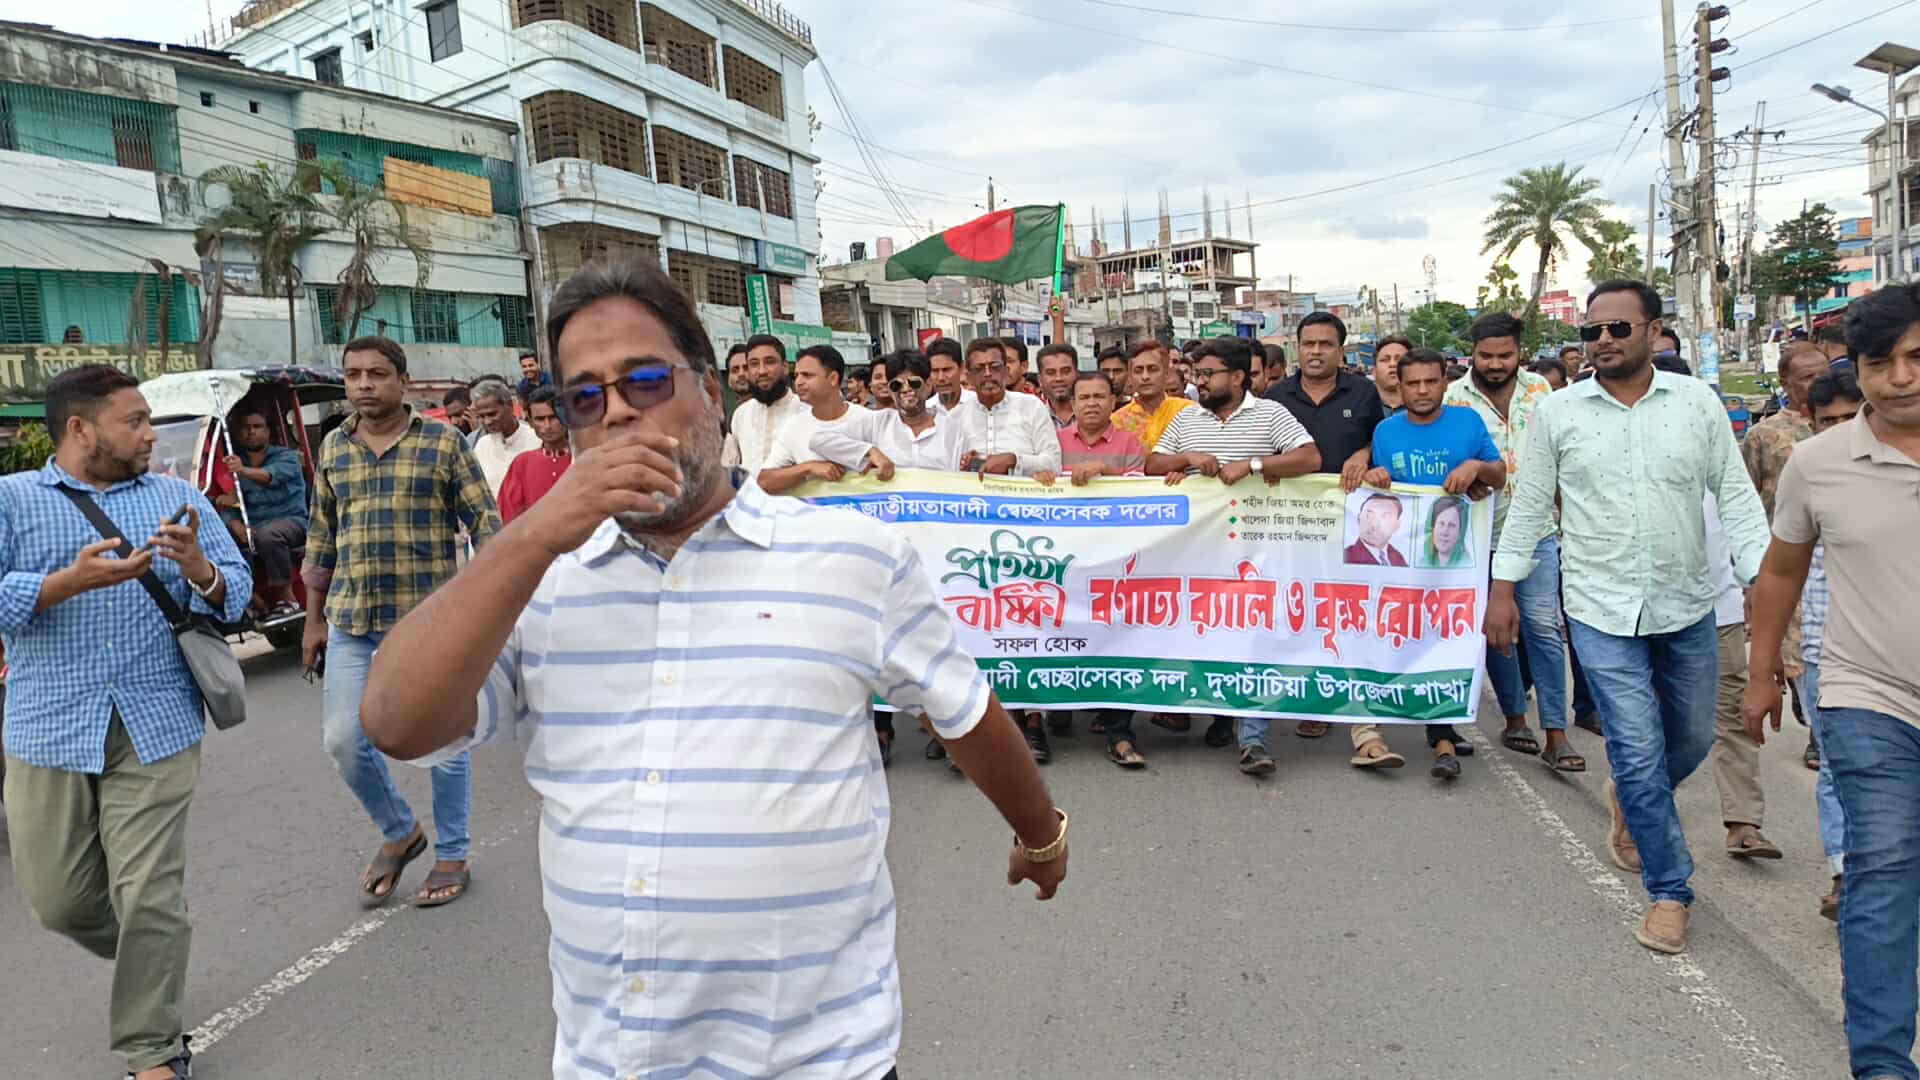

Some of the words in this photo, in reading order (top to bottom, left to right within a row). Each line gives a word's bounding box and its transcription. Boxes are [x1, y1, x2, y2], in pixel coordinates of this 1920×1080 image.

[1266, 496, 1288, 508] জিয়া
[997, 503, 1113, 521] স্বেচ্ছাসেবক
[1118, 503, 1179, 520] দলের
[1241, 514, 1270, 526] খালেদা
[1273, 513, 1294, 526] জিয়া
[1297, 514, 1337, 528] জিন্দাবাদ
[1240, 531, 1264, 542] তারেক
[940, 529, 1076, 590] প্রতিষ্ঠা
[1088, 552, 1183, 627] বর্ণাঢ্য
[1286, 581, 1306, 634] ও
[1313, 582, 1372, 660] বৃক্ষ
[1377, 586, 1479, 650] রোপন
[993, 637, 1038, 653] সফল
[1044, 637, 1088, 653] হোক
[1027, 666, 1145, 691] স্বেচ্ছাসেবক
[1205, 667, 1309, 700] দুপচাঁচিয়া
[1314, 669, 1406, 706] উপজেলা
[1411, 679, 1469, 705] শাখা
